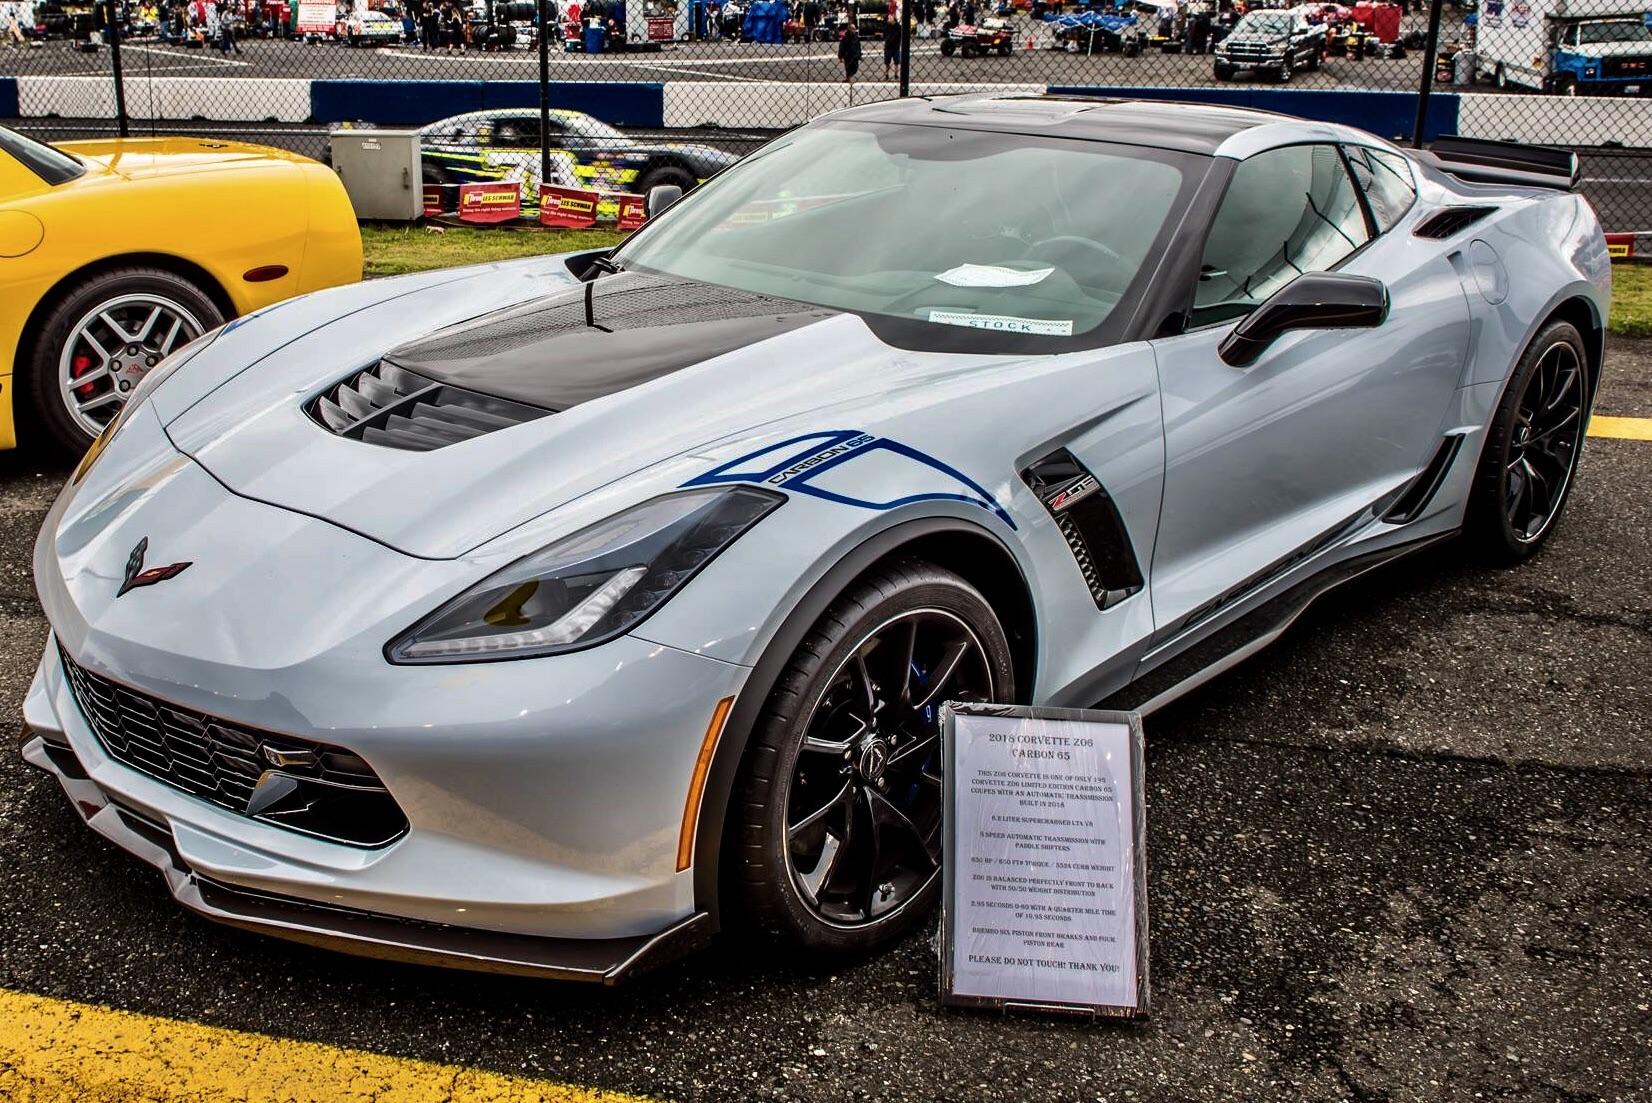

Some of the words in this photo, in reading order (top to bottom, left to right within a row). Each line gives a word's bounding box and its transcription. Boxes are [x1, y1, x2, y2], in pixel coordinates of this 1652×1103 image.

[561, 199, 571, 207] LES
[570, 201, 591, 210] SCHWAB
[969, 320, 1031, 331] STOCK
[768, 445, 849, 484] CARBON
[846, 434, 875, 448] 65
[989, 733, 1015, 743] 2018
[1017, 735, 1071, 746] CORVETTE
[1012, 749, 1054, 760] CARBON
[1057, 751, 1071, 761] 65
[1007, 771, 1041, 780] CORVETTE
[971, 778, 1005, 787] CORVETTE
[1021, 781, 1047, 789] LIMITED
[1048, 783, 1074, 791] EDITION
[1075, 784, 1102, 792] CARBON
[970, 787, 996, 795] COUPES
[1026, 790, 1063, 799] AUTOMATIC
[1065, 793, 1114, 802] TRANSMISSION
[1021, 816, 1071, 826] SUPERCHARGED
[1006, 833, 1043, 842] AUTOMATIC
[1044, 836, 1089, 844] TRANSMISSION
[1040, 844, 1071, 852] SHIFTERS
[1025, 859, 1049, 868] TORQUE
[1072, 863, 1090, 871] CURB
[1090, 864, 1114, 872] WEIGHT
[993, 875, 1028, 884] BALANCED
[1028, 877, 1064, 886] PERFECTLY
[1027, 886, 1052, 894] WEIGHT
[1053, 888, 1096, 897] DISTRIBUTION
[986, 901, 1014, 909] SECONDS
[1053, 906, 1084, 914] QUARTER
[1084, 908, 1100, 916] MILE
[1043, 914, 1072, 922] SECONDS
[972, 927, 999, 935] BREMBO
[1011, 929, 1035, 937] PISTON
[1035, 931, 1056, 939] FRONT
[1056, 932, 1083, 941] BRAKES
[1083, 934, 1098, 942] AND
[1023, 939, 1046, 947] PISTON
[1046, 941, 1065, 949] REAR
[968, 954, 1002, 965] PLEASE
[1003, 957, 1015, 966] DO
[1017, 958, 1034, 967] NOT
[1035, 959, 1067, 970] TOUCH!
[1068, 961, 1098, 972] THANK
[1099, 963, 1120, 973] YOU!
